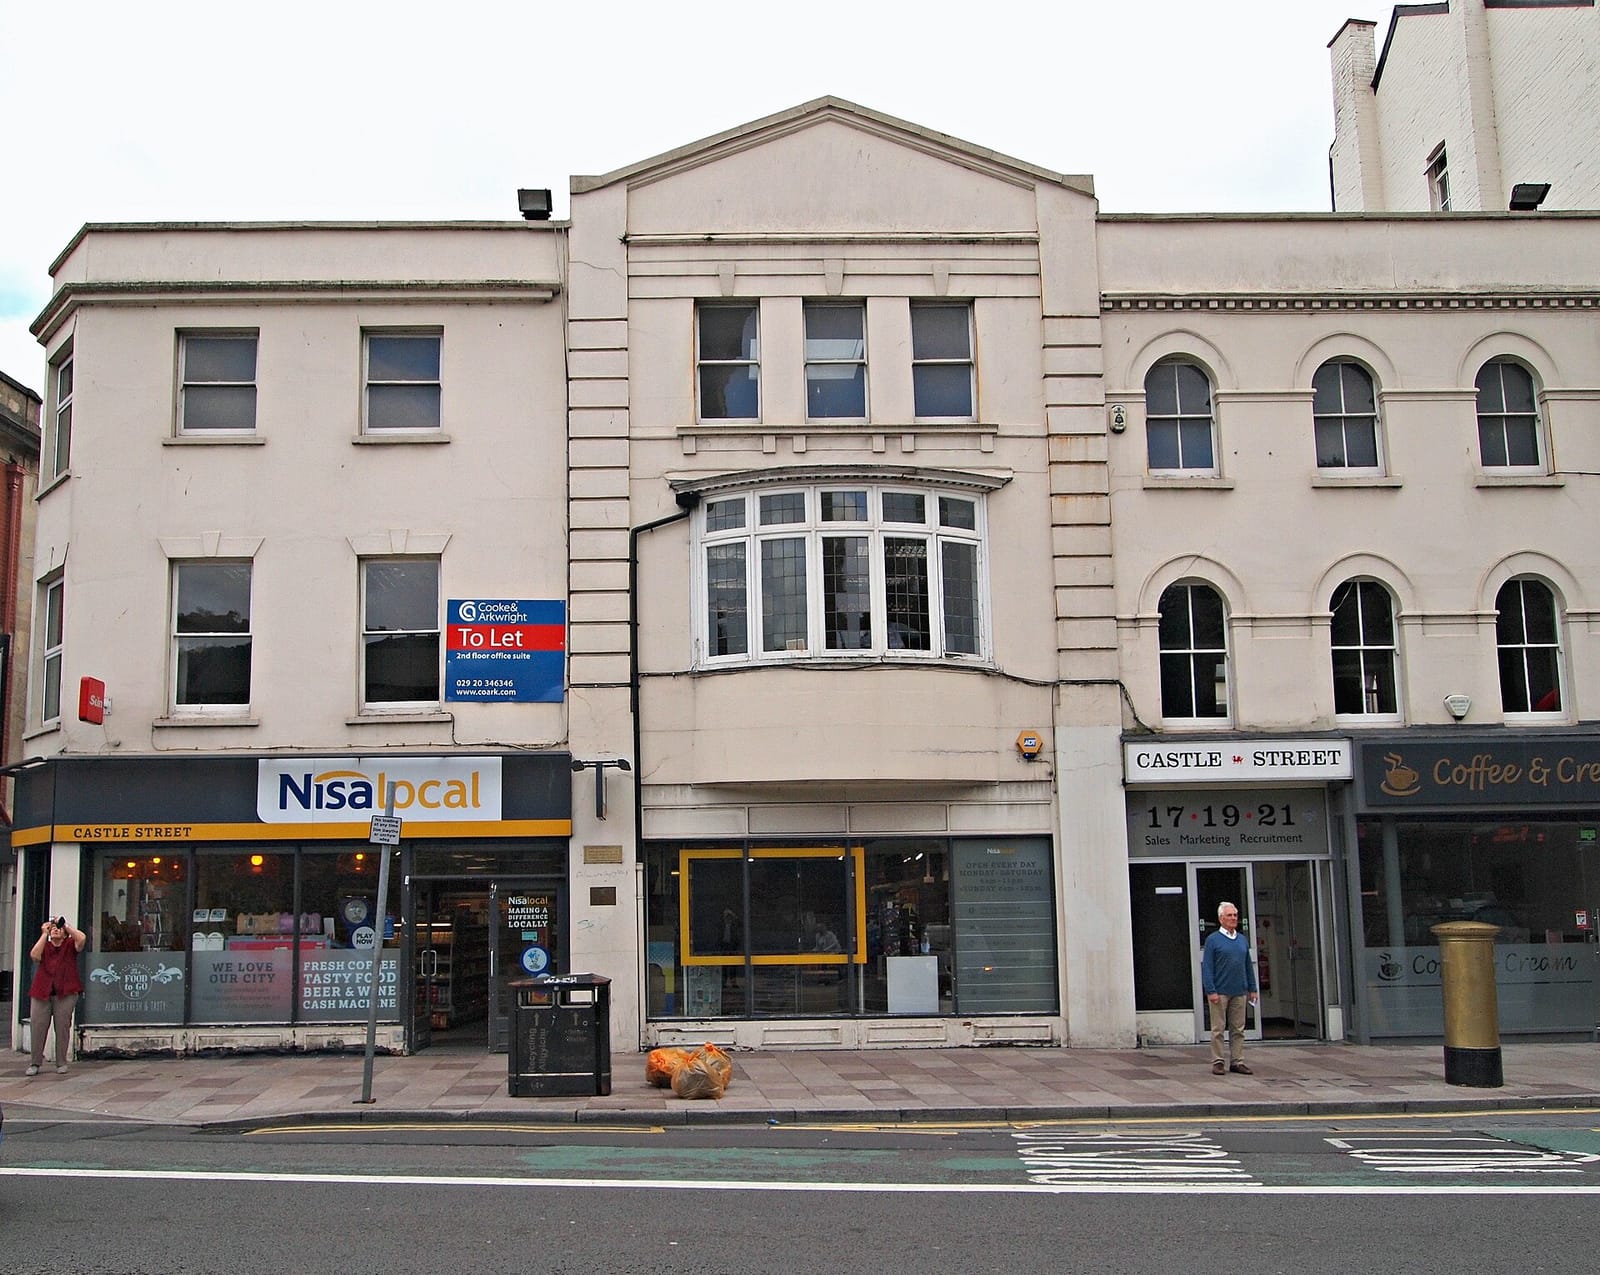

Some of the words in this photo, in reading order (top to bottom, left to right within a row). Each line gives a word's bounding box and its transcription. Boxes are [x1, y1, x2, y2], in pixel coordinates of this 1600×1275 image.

[478, 612, 527, 623] Arkwright
[457, 628, 484, 647] To
[490, 628, 524, 647] Let
[512, 652, 531, 660] suite
[456, 679, 471, 687] 029
[485, 679, 514, 687] 346346
[456, 688, 516, 696] www.coark.com
[1136, 751, 1222, 768] CASTLE
[1253, 750, 1341, 767] STREET
[1432, 753, 1523, 791] Coffee
[1528, 757, 1551, 786] &
[279, 770, 481, 810] Nisalocal
[1147, 806, 1185, 828] 17
[1203, 804, 1241, 827] 19
[1257, 803, 1296, 826] 21
[73, 827, 130, 838] CASTLE
[135, 827, 192, 838] STREET
[1145, 835, 1170, 846] Sales
[1180, 834, 1231, 847] Marketing
[1240, 833, 1303, 844] Recruitment
[508, 896, 548, 905] Nisalocal
[508, 920, 549, 928] LOCALLY
[212, 962, 233, 973] WE
[238, 962, 273, 972] LOVE
[303, 961, 345, 971] FRESH
[347, 960, 397, 970] COFEE
[124, 974, 148, 983] FOOD
[209, 974, 238, 984] OUR
[243, 973, 276, 984] CITY
[303, 973, 352, 984] TASTY
[124, 983, 133, 991] to
[136, 982, 148, 991] GO
[303, 986, 341, 997] BEER
[345, 986, 355, 997] &
[357, 985, 397, 997] WNE
[302, 1000, 337, 1010] CASH
[338, 999, 397, 1009] MACNE
